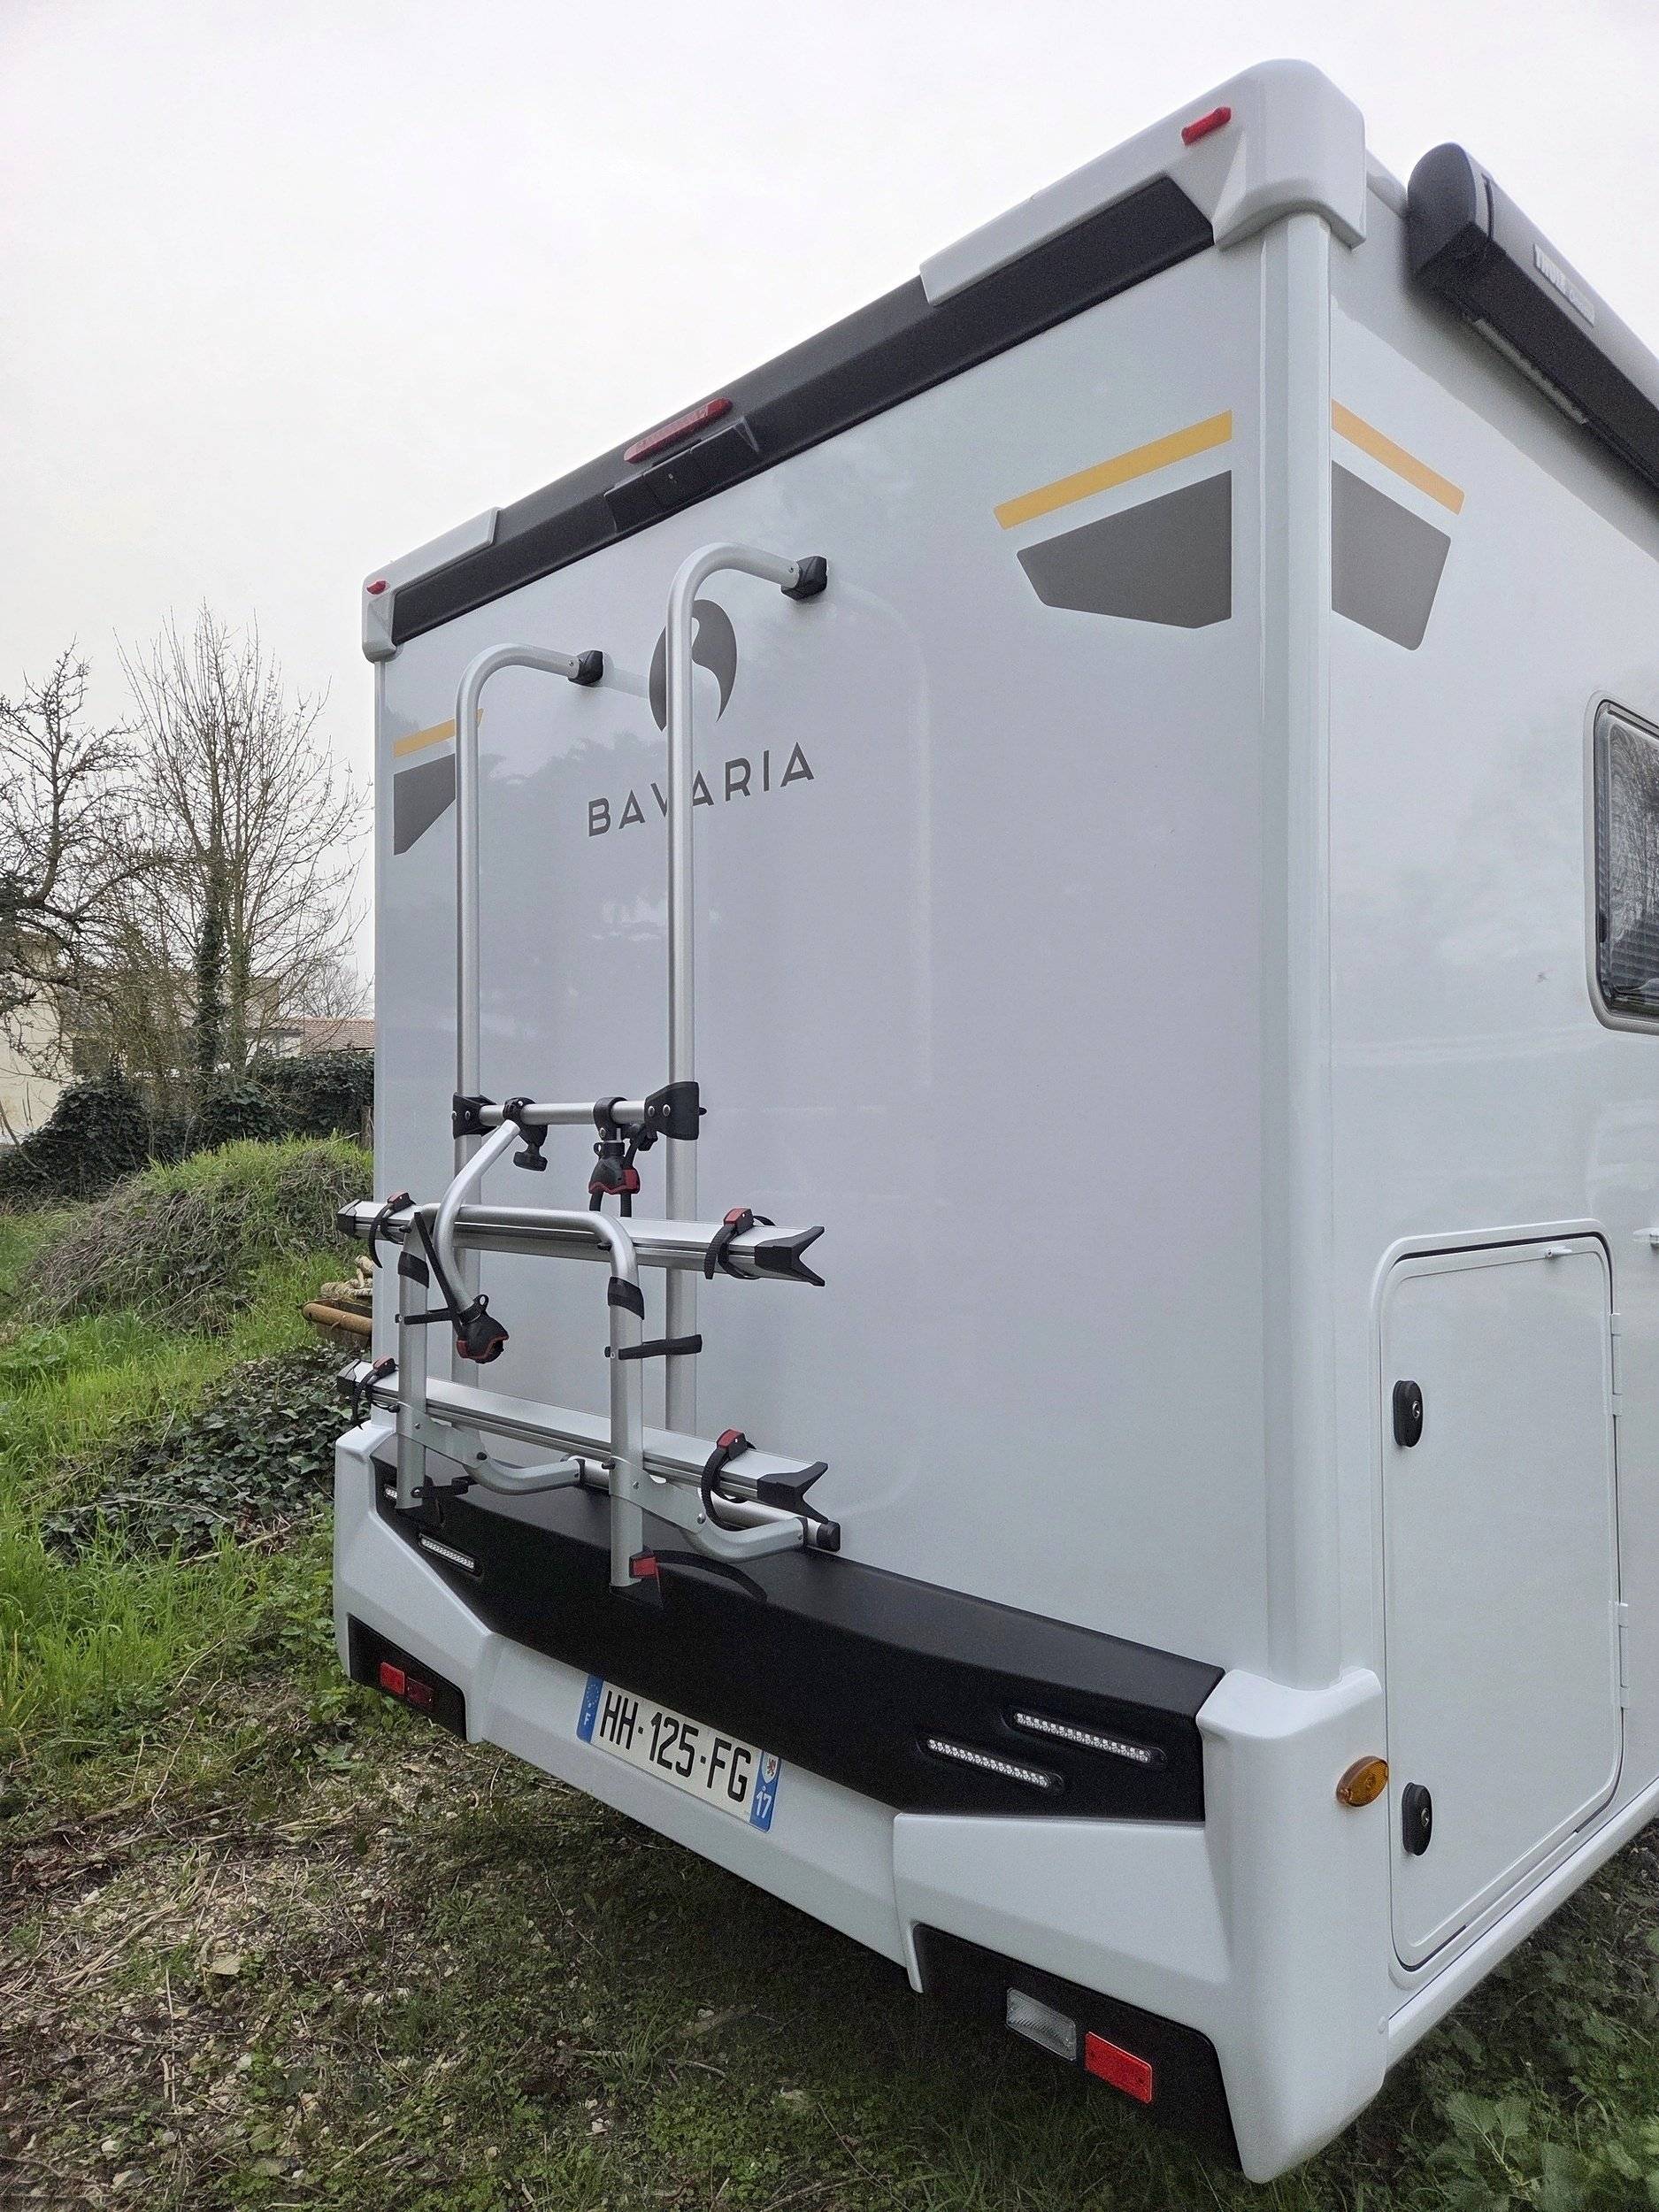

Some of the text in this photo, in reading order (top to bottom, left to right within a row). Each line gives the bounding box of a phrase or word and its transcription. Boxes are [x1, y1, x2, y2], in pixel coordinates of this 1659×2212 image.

[588, 741, 814, 837] BAVARIA
[583, 1712, 591, 1724] F
[599, 1690, 752, 1803] HH-125-FG
[756, 1790, 772, 1819] 17
